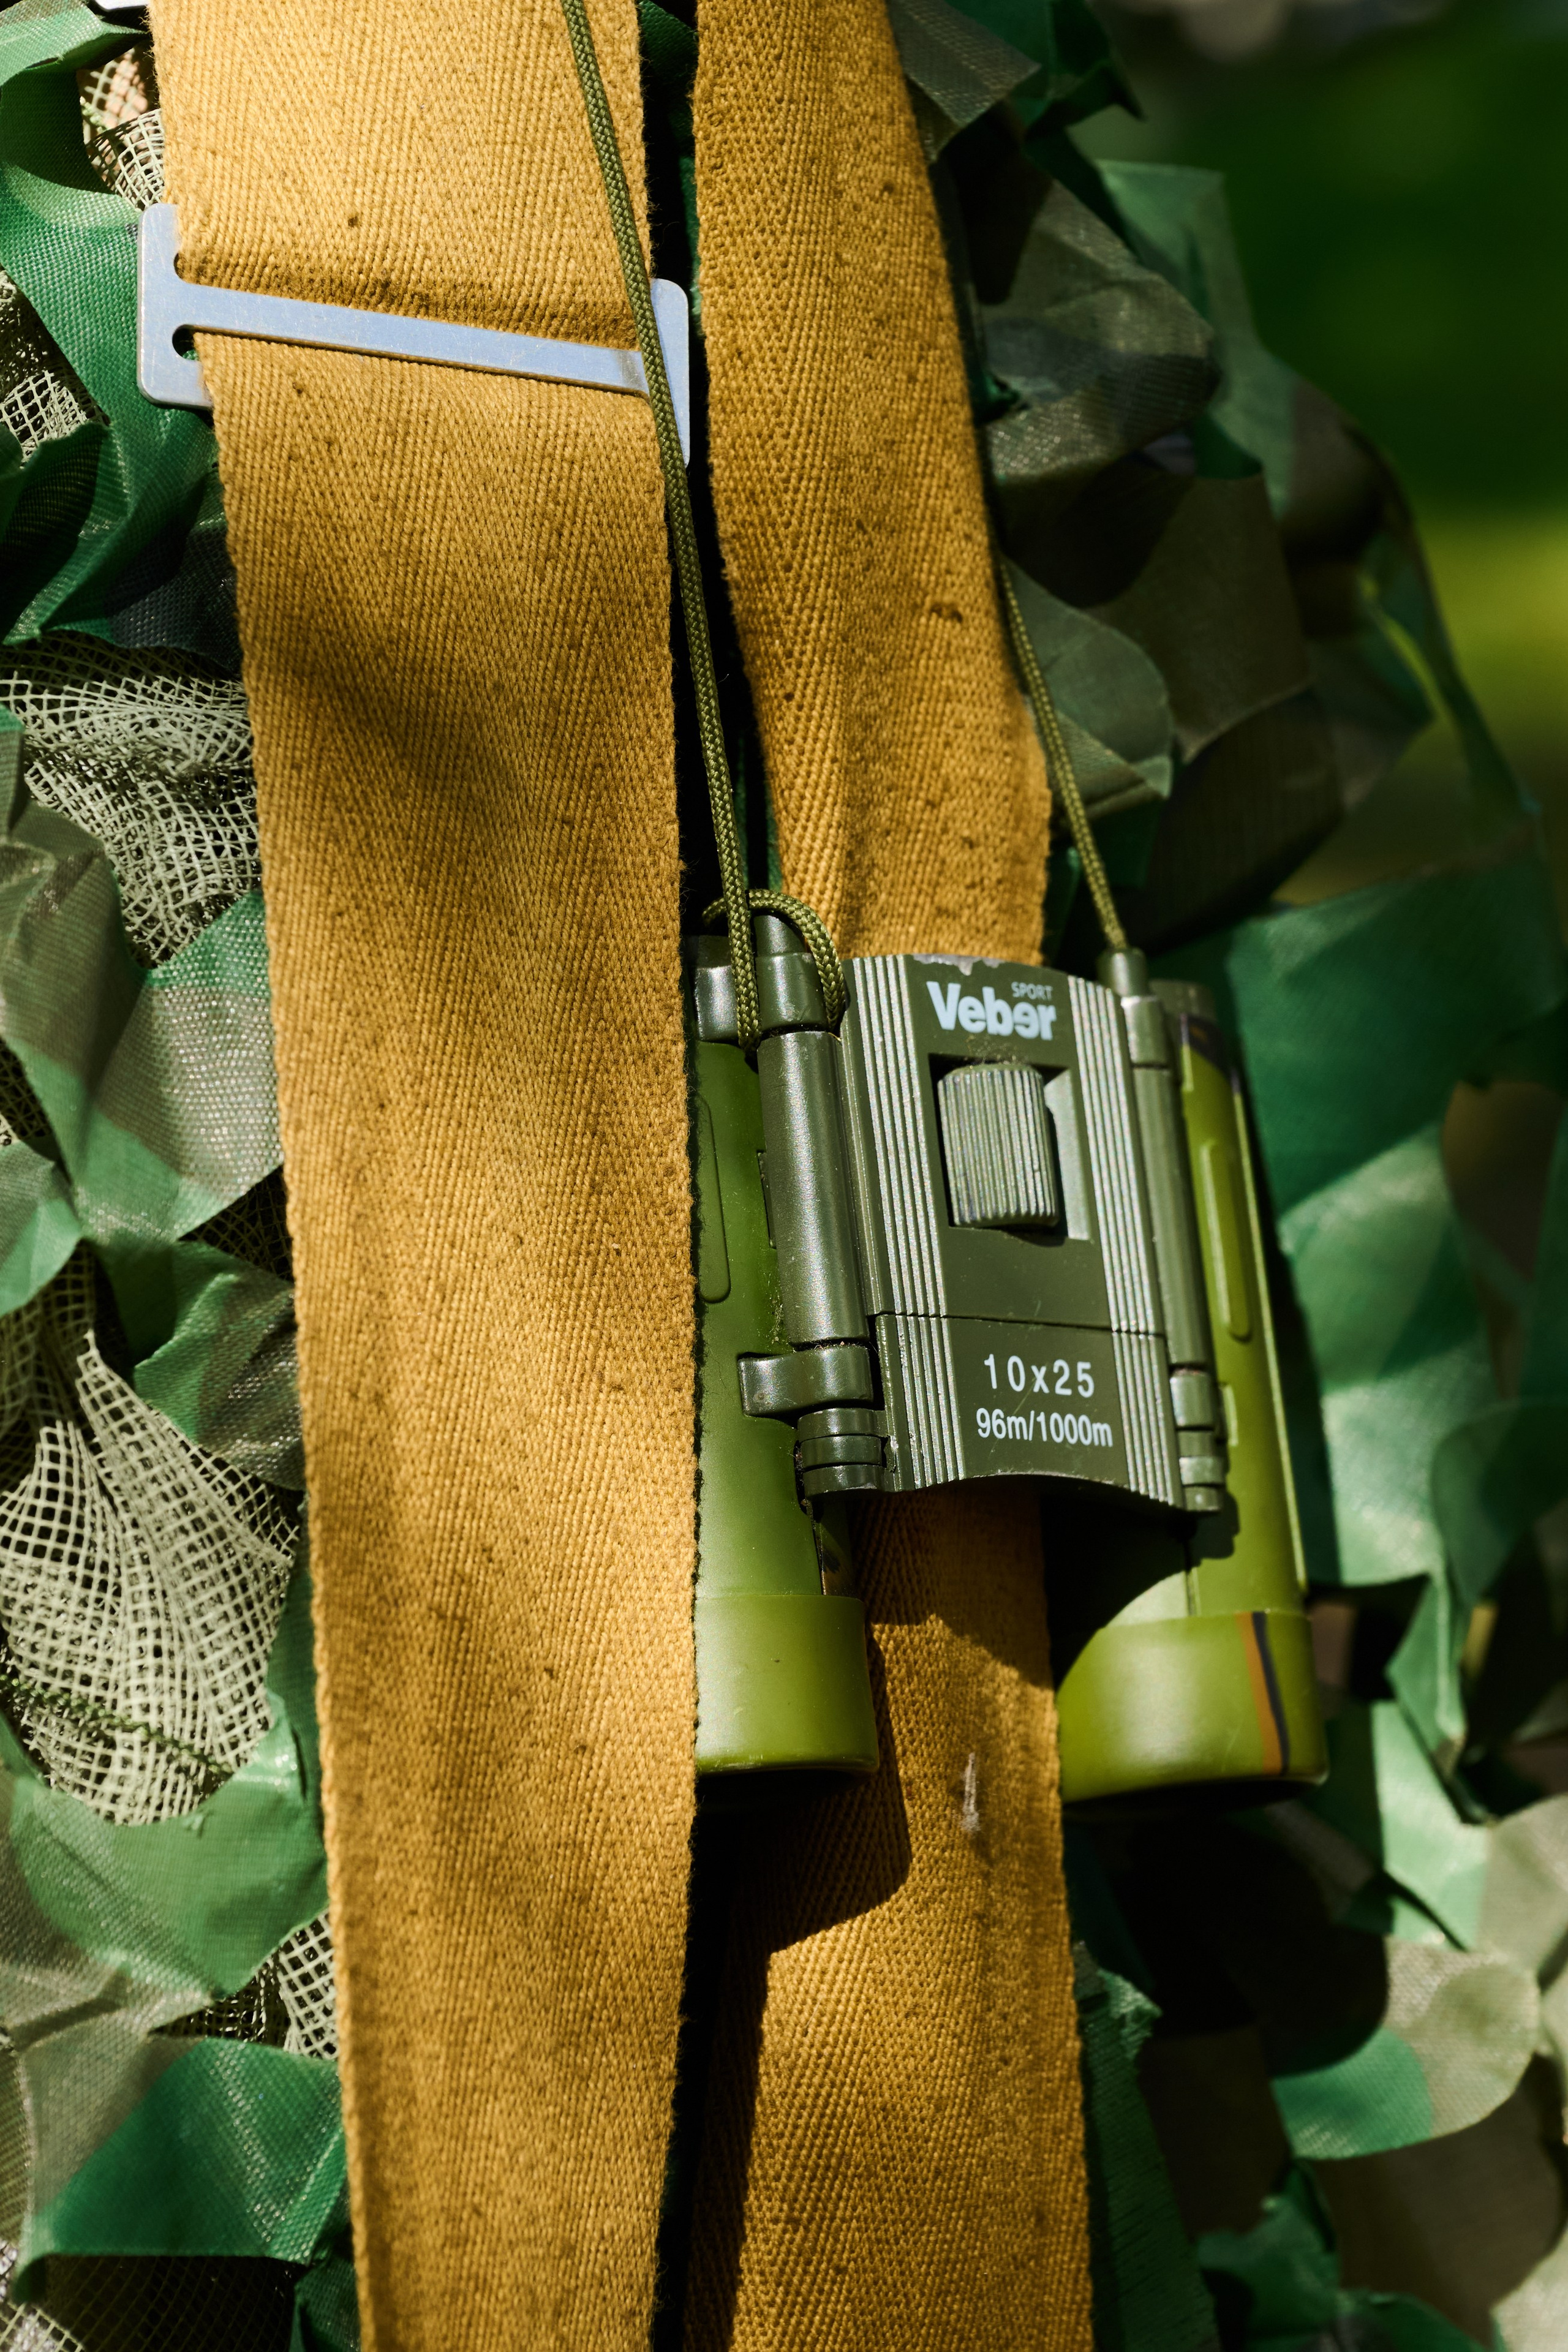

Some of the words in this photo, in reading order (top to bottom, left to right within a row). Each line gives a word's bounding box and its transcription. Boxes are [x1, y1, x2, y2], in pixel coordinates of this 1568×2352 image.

[926, 981, 1057, 1041] Veber
[1011, 982, 1053, 1000] SPORT
[984, 1354, 1095, 1398] 10x25
[976, 1408, 1113, 1447] 96m/1000m
